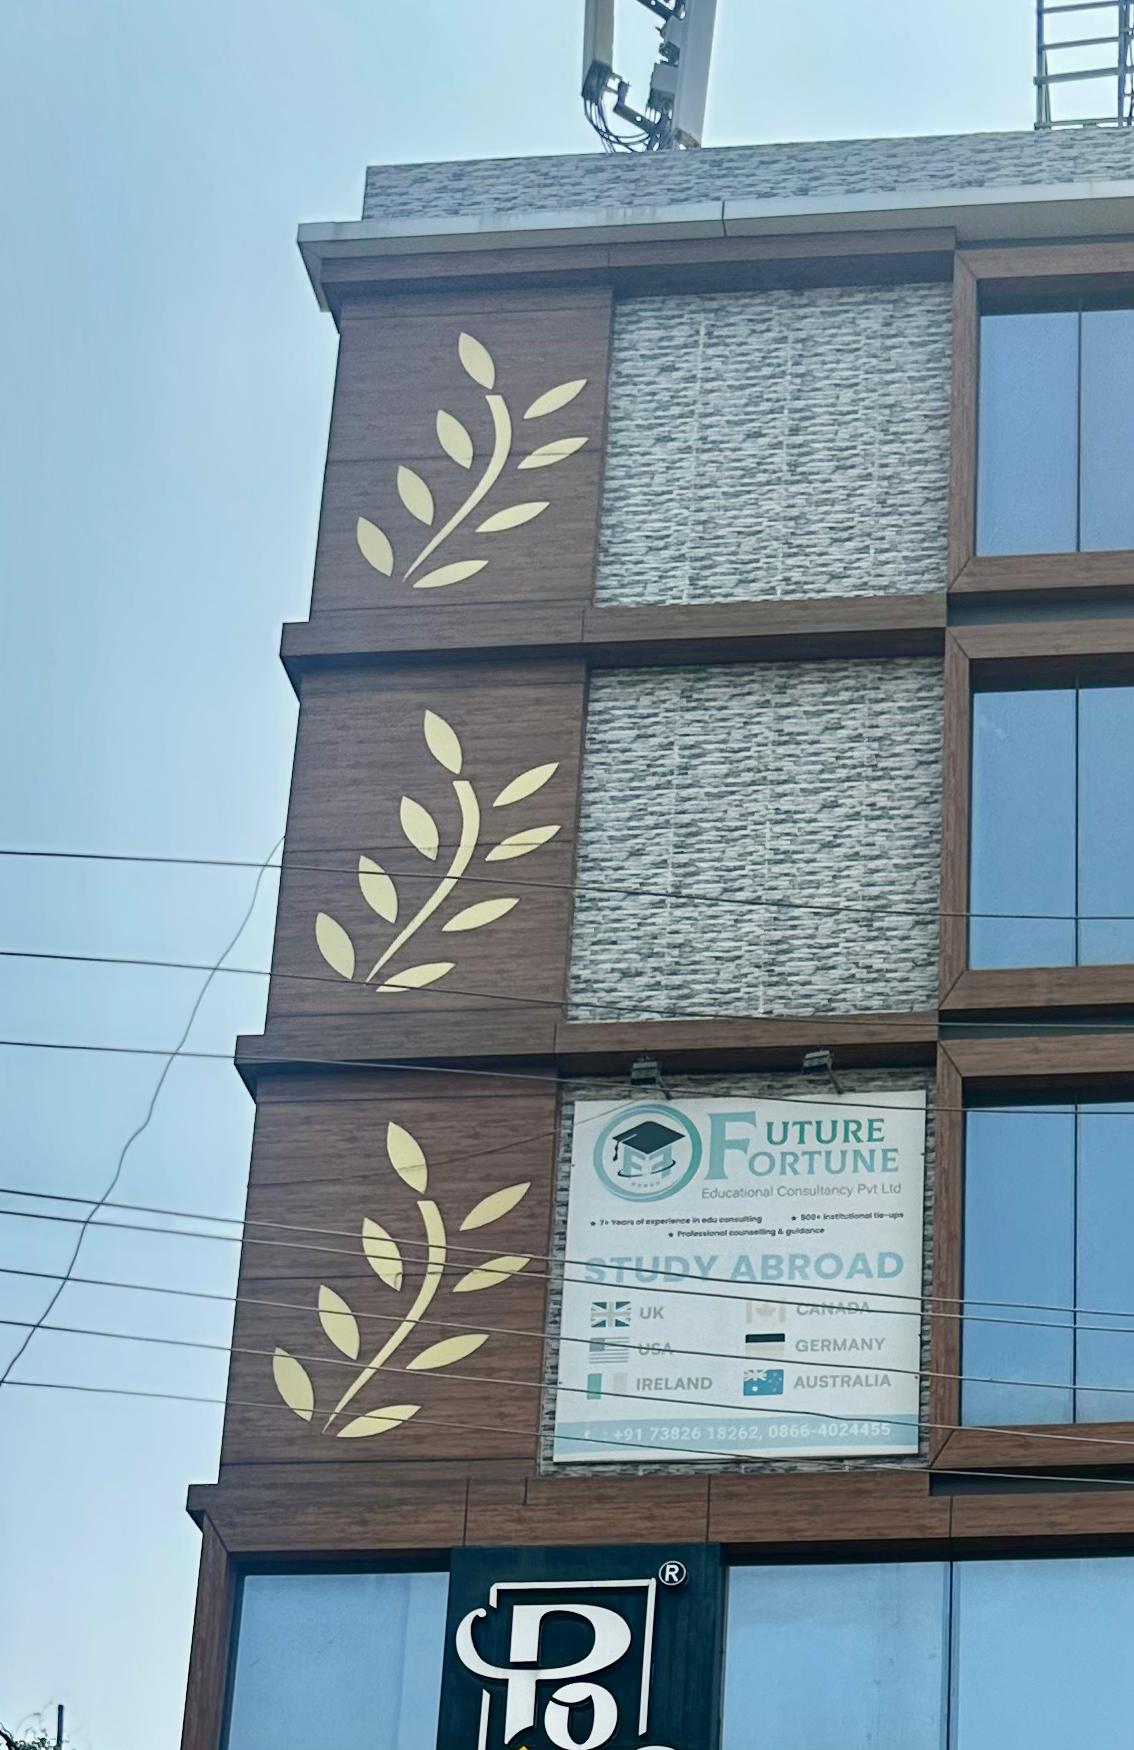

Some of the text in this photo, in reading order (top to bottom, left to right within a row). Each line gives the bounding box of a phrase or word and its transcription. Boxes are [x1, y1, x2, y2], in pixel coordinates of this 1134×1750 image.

[701, 1182, 901, 1199] Educational Consultancy Pvt Ltd
[719, 1214, 763, 1224] consulting
[677, 1229, 728, 1238] Professional
[786, 1226, 825, 1237] guidance
[584, 1252, 904, 1284] STUDY ABROAD
[639, 1306, 665, 1319] UK
[796, 1301, 871, 1316] CANADA
[638, 1342, 673, 1356] USA
[795, 1337, 885, 1352] GERMANY
[636, 1376, 713, 1391] IRELAND
[793, 1374, 892, 1389] AUSTRALIA
[614, 1427, 642, 1441] +91
[650, 1426, 701, 1441] 73826
[768, 1422, 891, 1439] 0866-4024455
